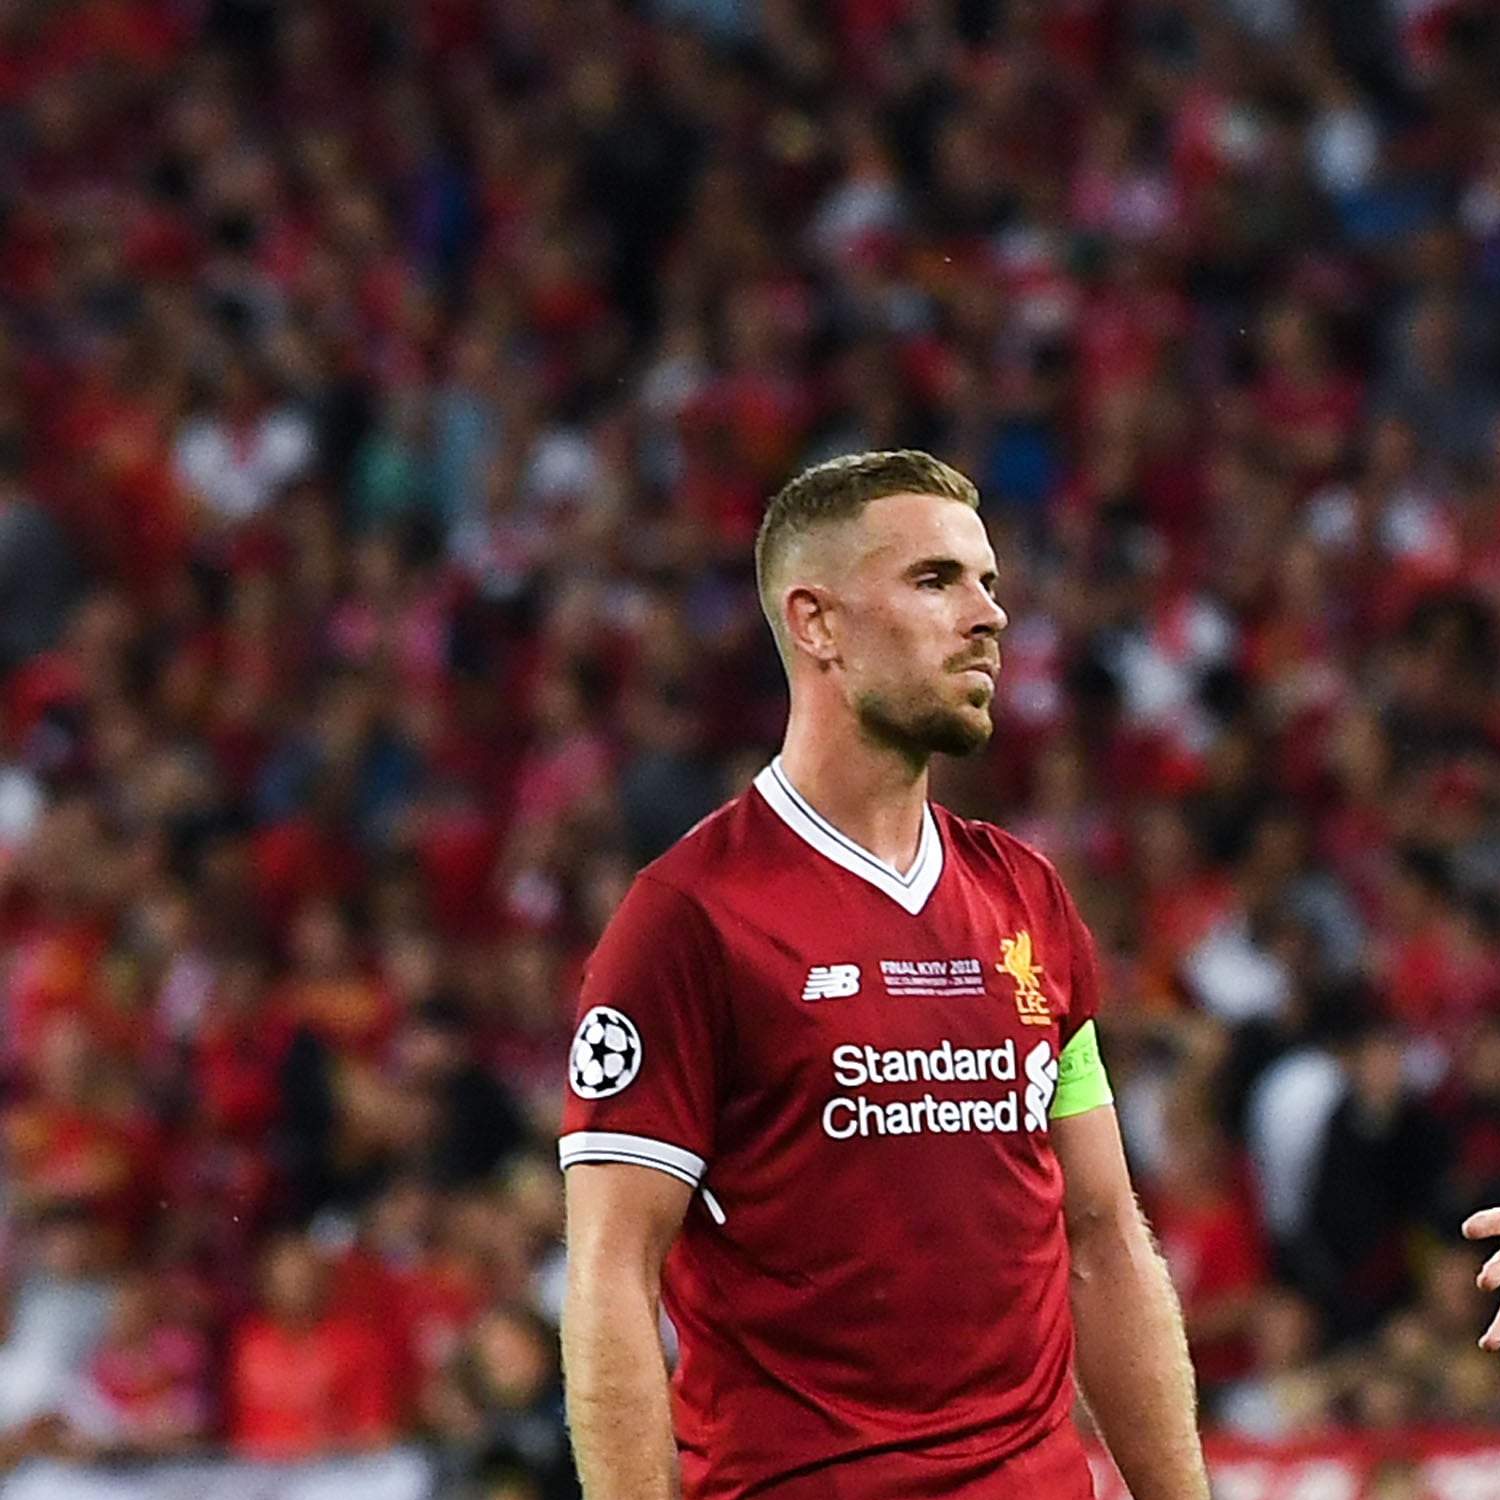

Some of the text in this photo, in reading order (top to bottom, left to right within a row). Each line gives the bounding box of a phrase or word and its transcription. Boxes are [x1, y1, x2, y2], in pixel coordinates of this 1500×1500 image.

[1015, 995, 1050, 1014] LFC
[832, 1038, 1016, 1087] Standard
[822, 1091, 1018, 1139] Chartered
